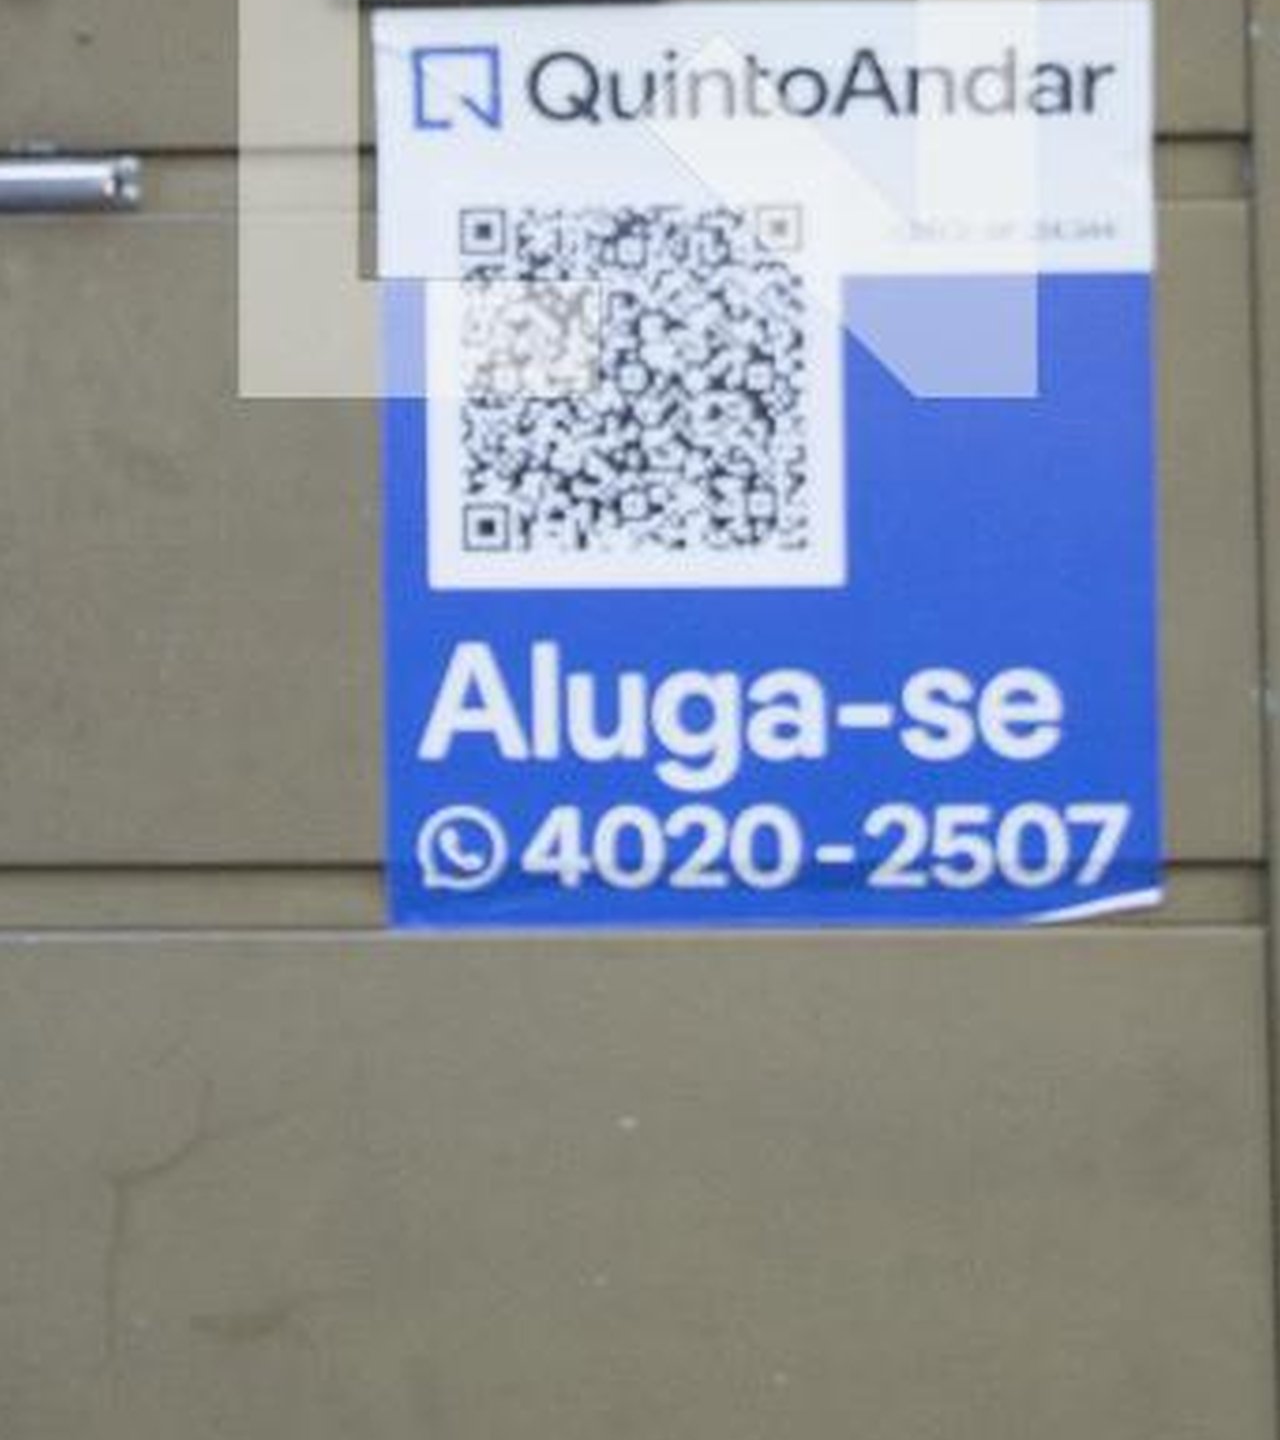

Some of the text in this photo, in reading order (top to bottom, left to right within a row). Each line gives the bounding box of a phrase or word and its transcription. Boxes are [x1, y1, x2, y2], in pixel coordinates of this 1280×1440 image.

[526, 46, 1116, 124] QuintoAndar
[417, 640, 1064, 792] Aluga-se
[521, 802, 1131, 889] 4020-2507
